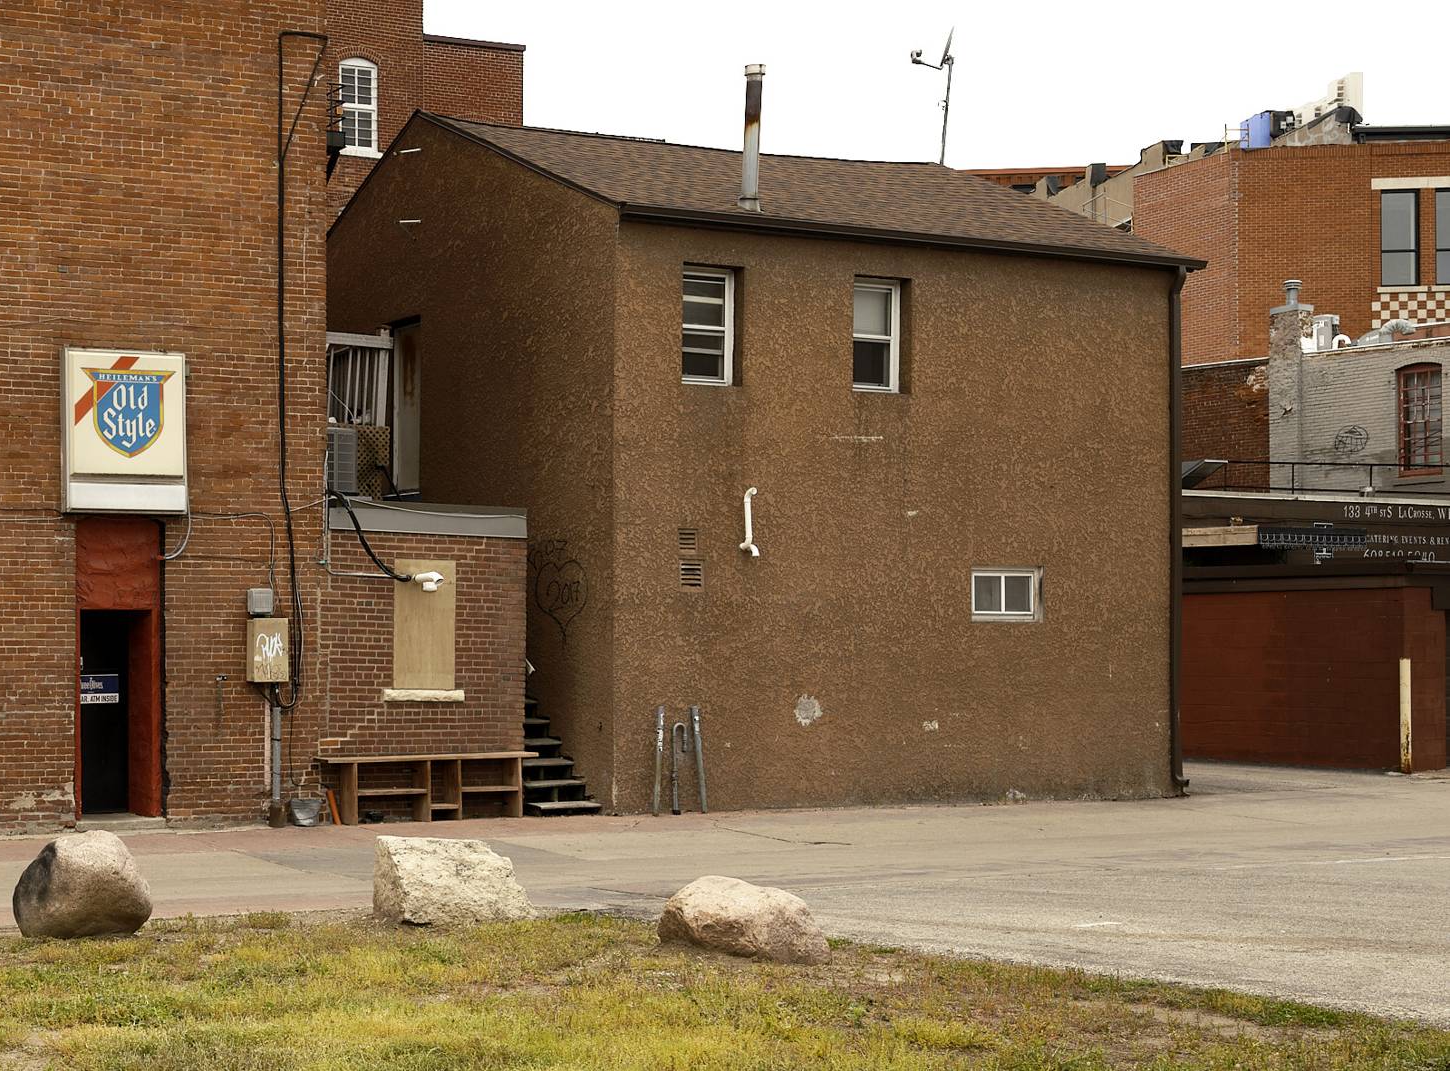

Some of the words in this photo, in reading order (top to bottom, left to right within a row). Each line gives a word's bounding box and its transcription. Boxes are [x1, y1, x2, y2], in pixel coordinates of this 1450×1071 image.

[113, 384, 148, 411] Old
[103, 407, 156, 448] Style
[1343, 505, 1361, 518] 133
[1401, 535, 1426, 545] EVENTS
[101, 694, 117, 702] INSIDE
